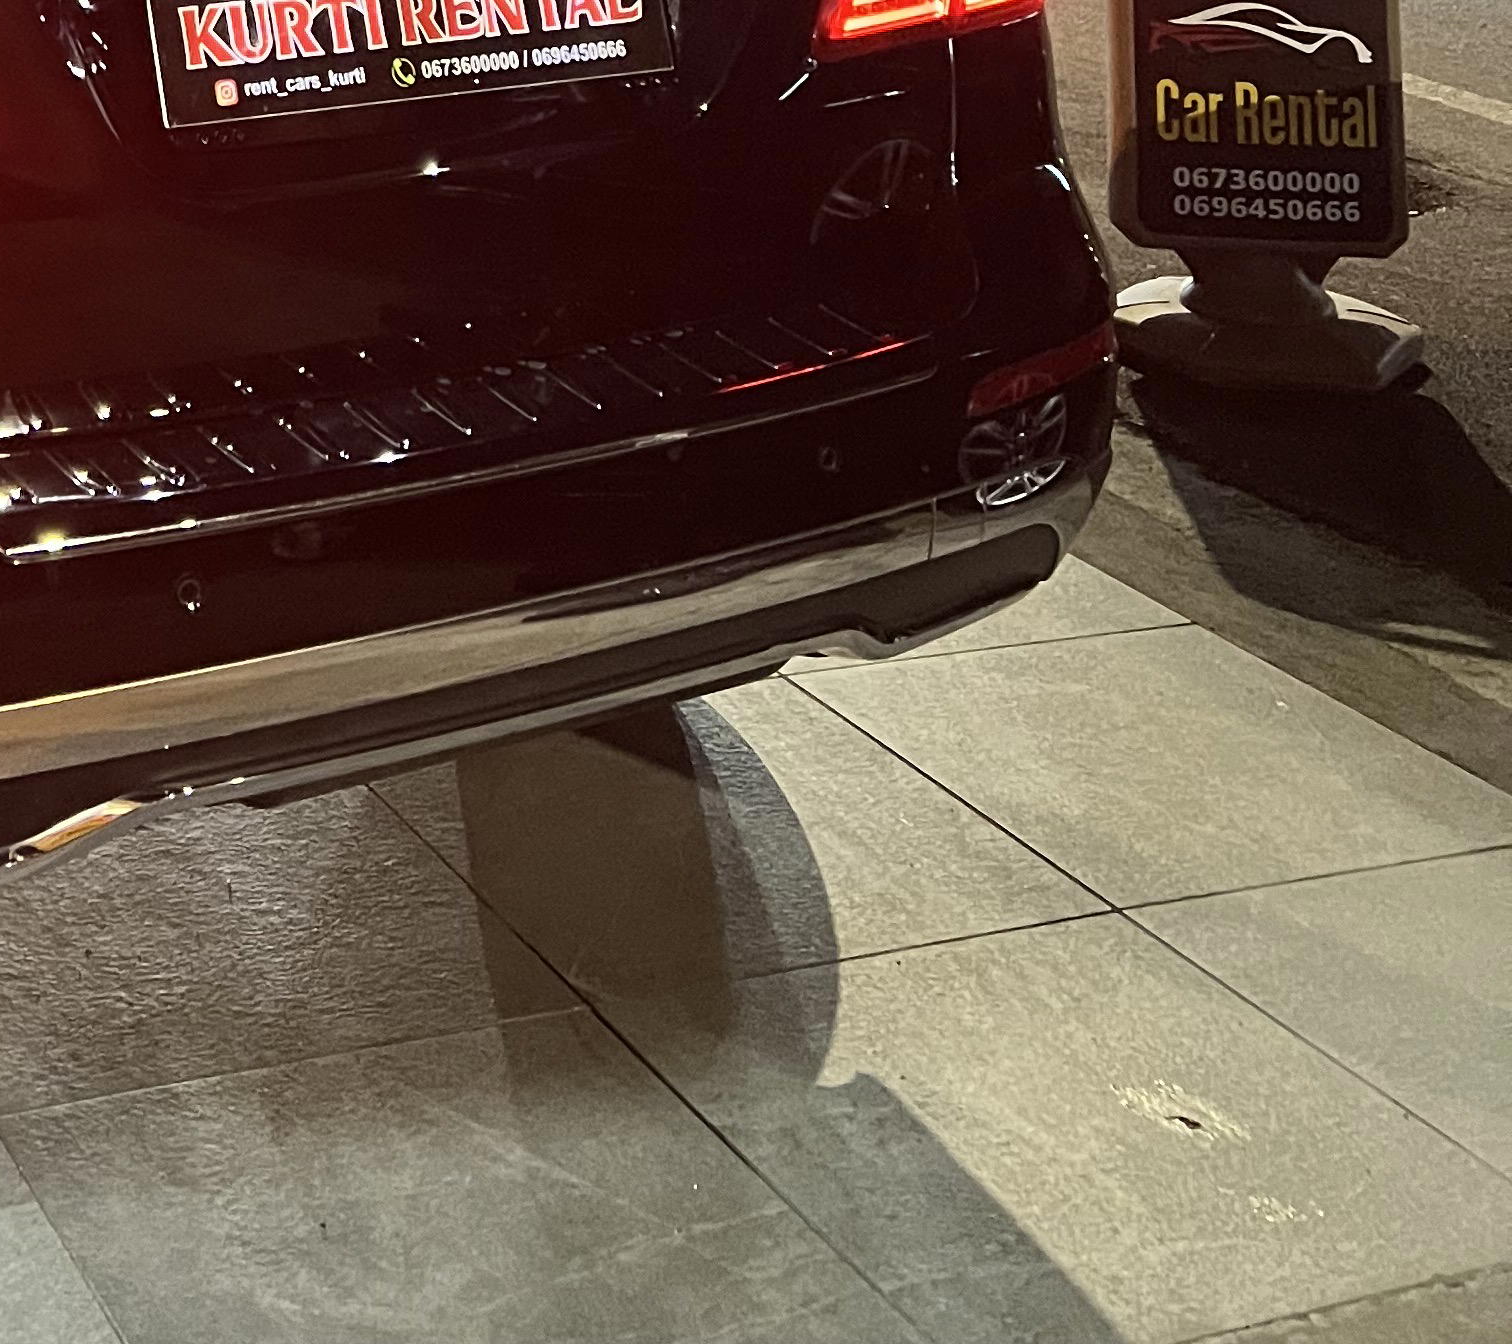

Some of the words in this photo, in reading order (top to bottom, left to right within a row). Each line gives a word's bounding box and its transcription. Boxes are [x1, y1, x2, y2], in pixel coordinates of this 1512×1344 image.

[420, 50, 520, 79] 0673600000
[531, 39, 627, 67] 0696450666
[243, 66, 367, 98] rent_cars_kurti
[1156, 78, 1224, 143] Car
[1234, 81, 1378, 148] Rental
[1173, 166, 1361, 194] 0673600000
[1173, 194, 1361, 223] 0696450666
